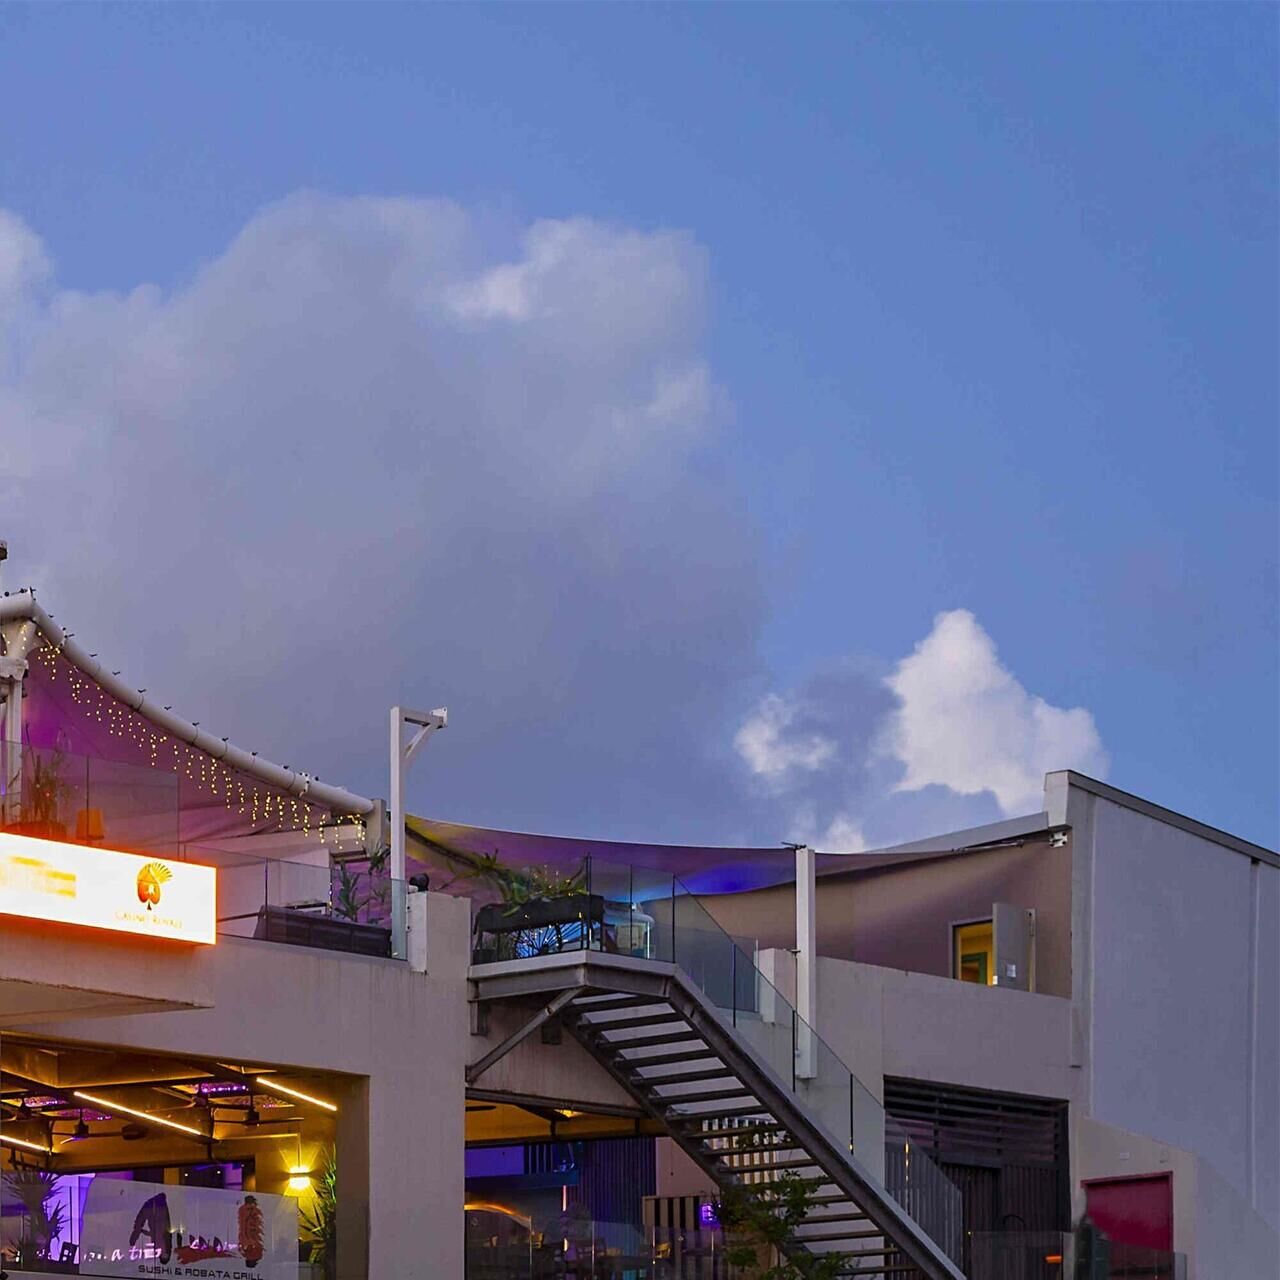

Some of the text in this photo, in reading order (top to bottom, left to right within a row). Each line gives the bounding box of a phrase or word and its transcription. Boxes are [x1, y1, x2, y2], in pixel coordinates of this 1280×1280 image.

[138, 1264, 264, 1280] SUSHI & ROBATA GRILL
